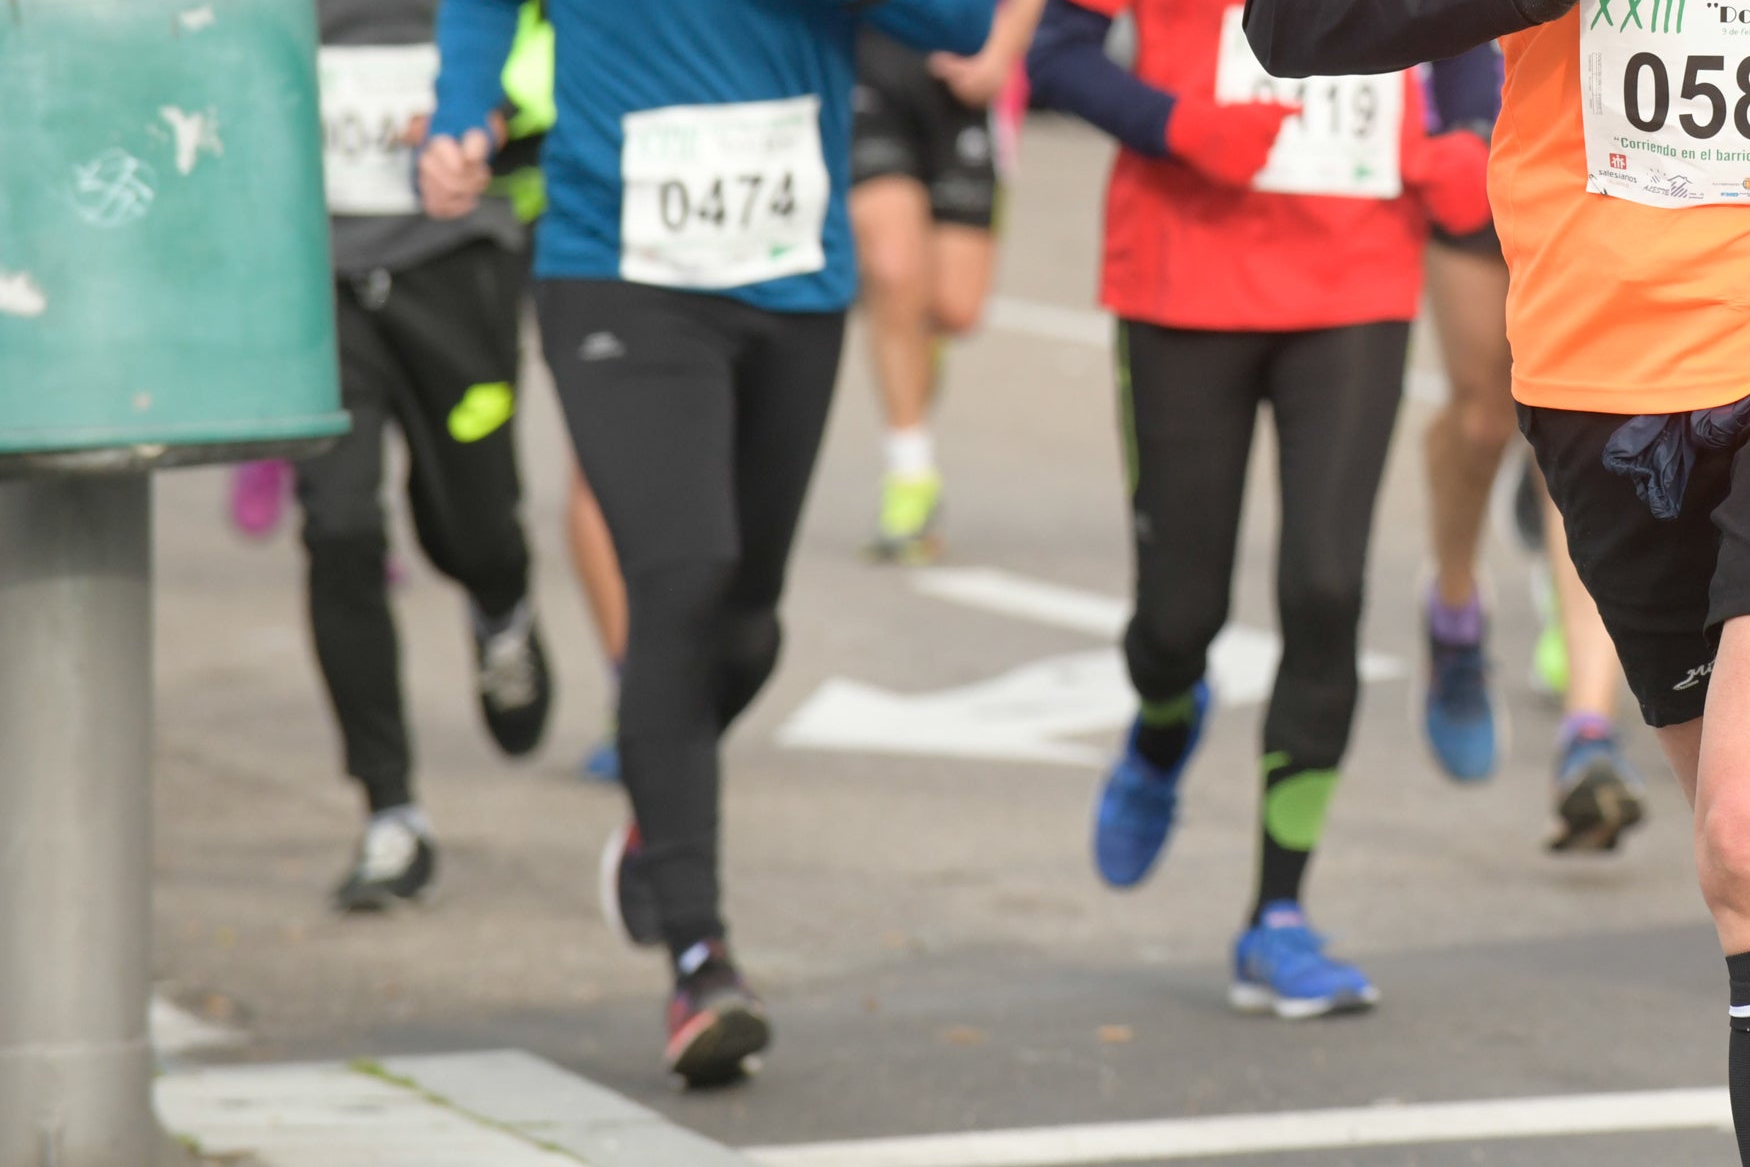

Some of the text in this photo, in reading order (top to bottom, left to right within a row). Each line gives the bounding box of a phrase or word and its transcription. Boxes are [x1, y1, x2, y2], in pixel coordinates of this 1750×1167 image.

[1681, 149, 1696, 159] en
[1700, 148, 1711, 161] el
[1598, 169, 1638, 184] salesianos
[659, 171, 796, 231] 0474
